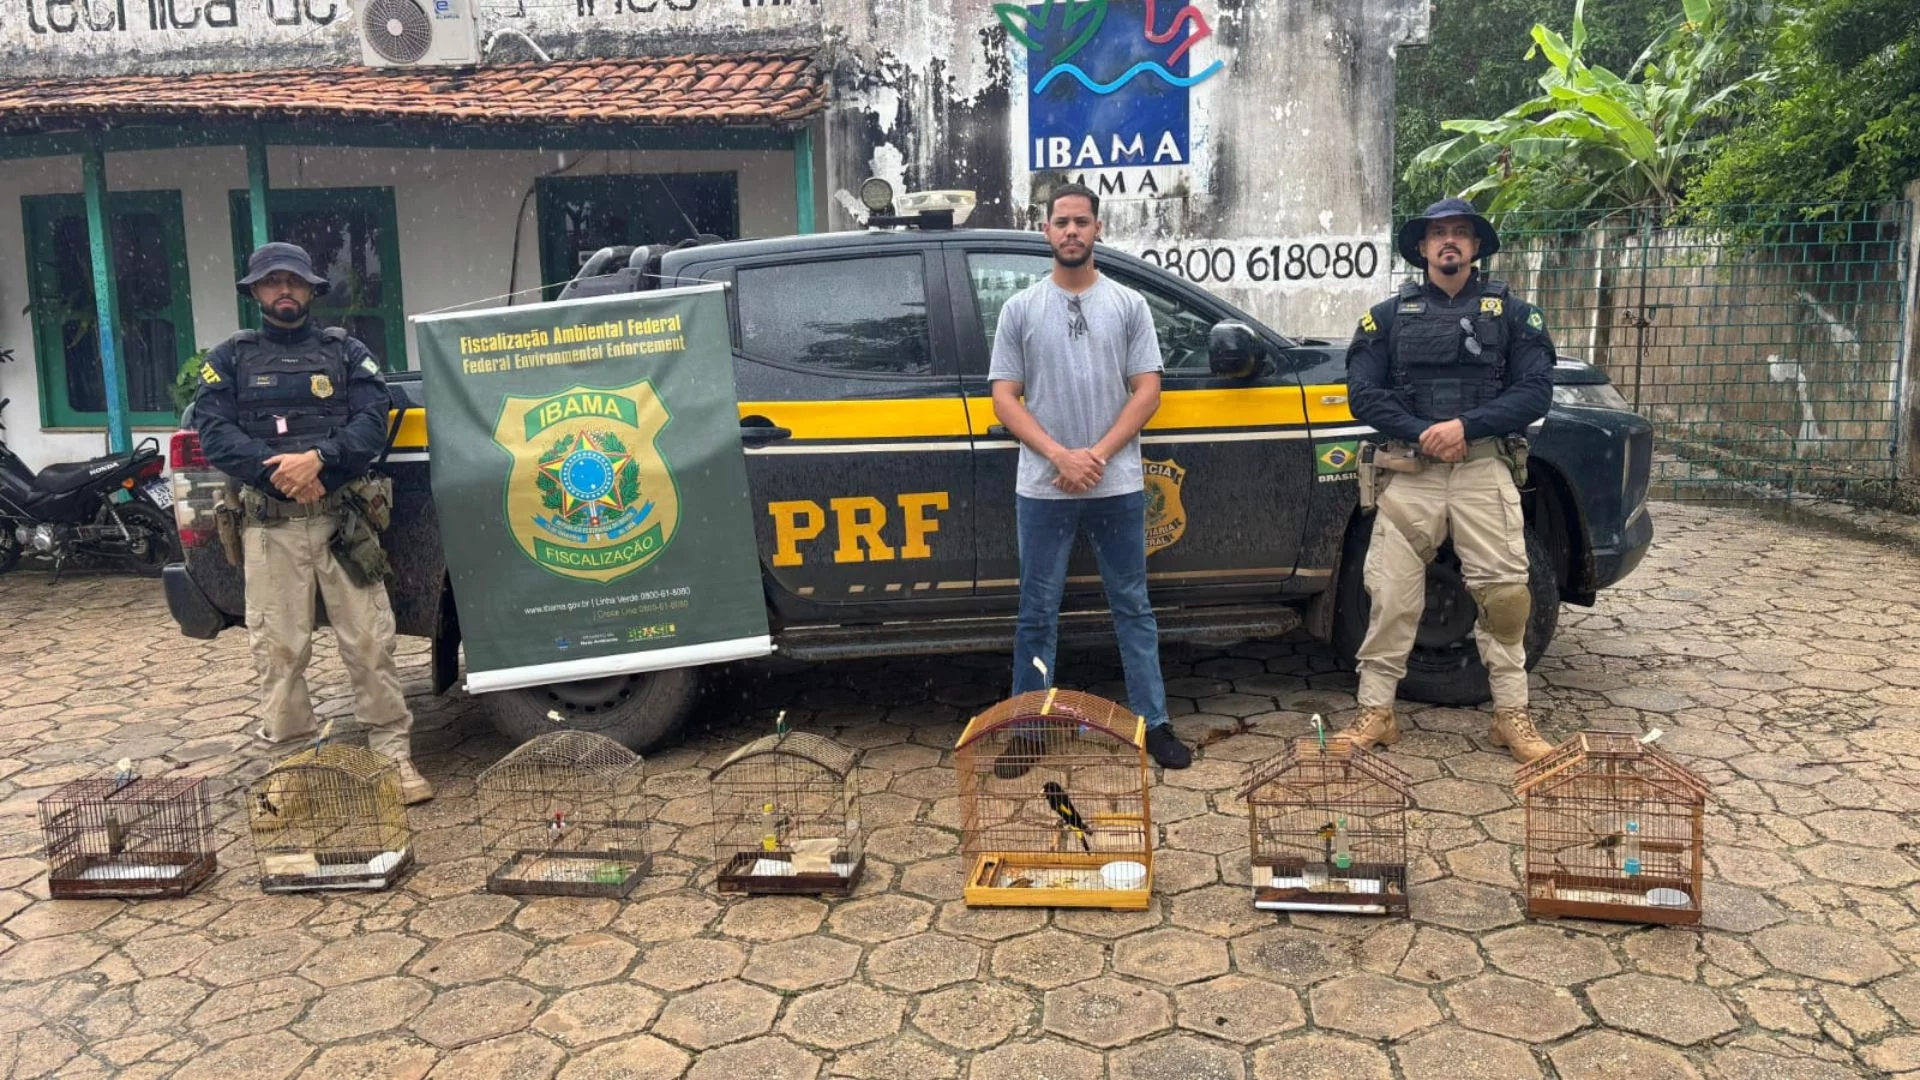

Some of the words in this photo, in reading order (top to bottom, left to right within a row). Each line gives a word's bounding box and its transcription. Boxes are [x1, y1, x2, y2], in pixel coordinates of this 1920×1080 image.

[1035, 130, 1183, 169] IBAMA
[1247, 241, 1378, 281] 618080
[460, 328, 548, 355] Fiscalização
[553, 321, 623, 344] Ambiental
[627, 314, 682, 335] Federal
[463, 355, 511, 374] Federal
[514, 344, 603, 369] Environmental
[607, 336, 686, 358] Enforcement
[540, 394, 622, 428] IBAMA
[89, 462, 120, 476] HONDA
[1143, 464, 1172, 477] ICIA
[1318, 472, 1361, 483] BRASIL
[768, 491, 949, 567] PRF
[546, 536, 653, 566] FISCALIZAÇÃO
